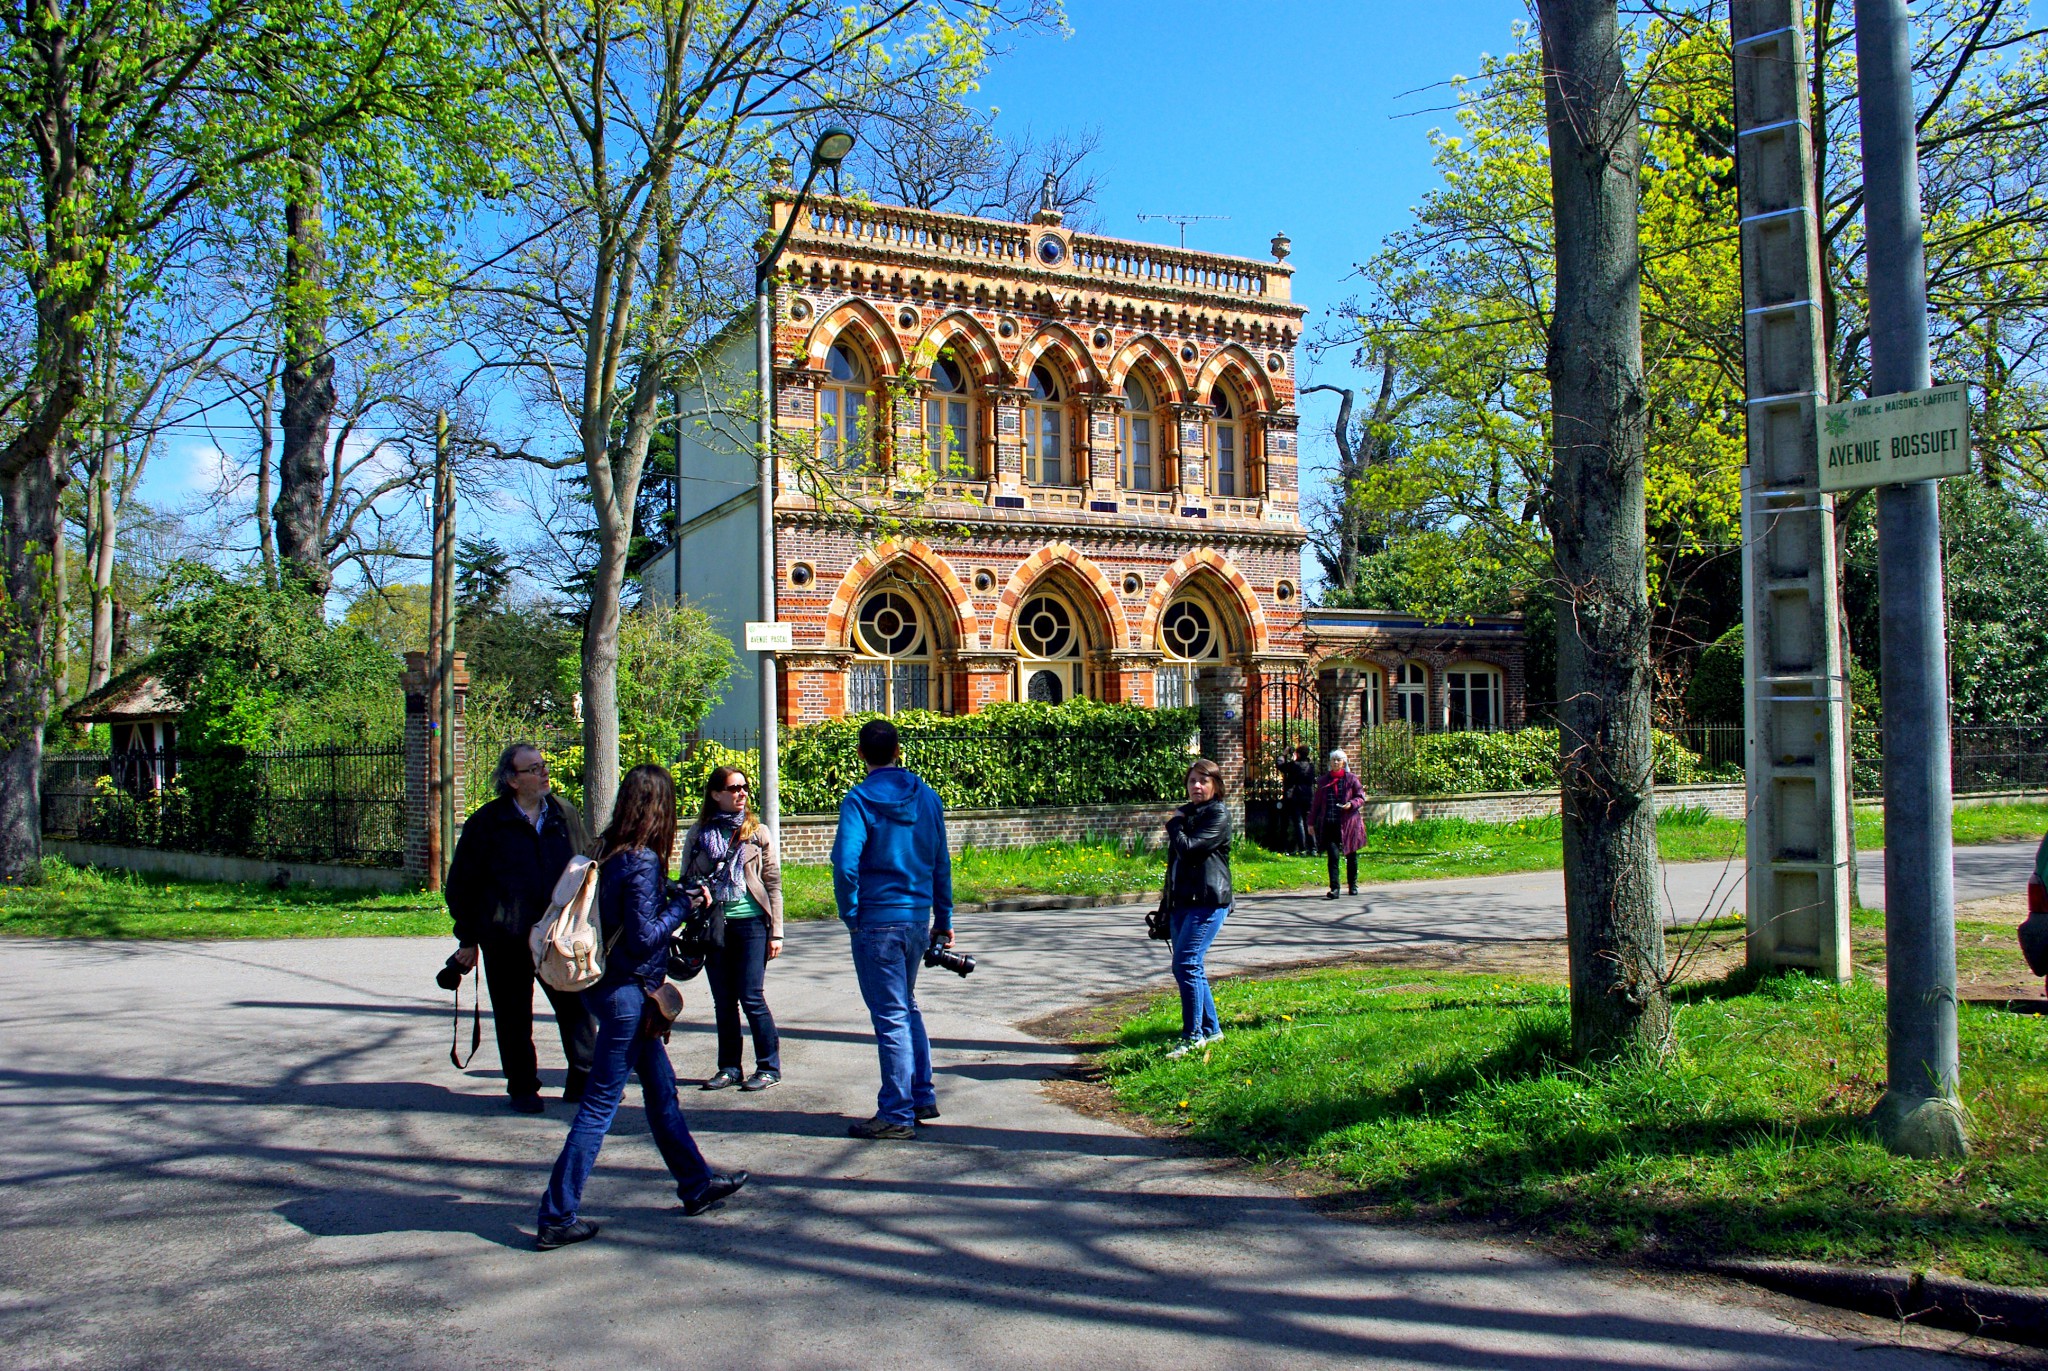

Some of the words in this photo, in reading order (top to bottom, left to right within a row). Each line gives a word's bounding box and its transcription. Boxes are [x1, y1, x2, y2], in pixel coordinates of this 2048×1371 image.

[1853, 405, 1871, 418] PARC
[1885, 391, 1959, 413] MAISONS-LAFFITTE
[1828, 440, 1881, 468] AVENUE
[1891, 428, 1958, 459] BOSSUET
[750, 635, 767, 643] AVENUE
